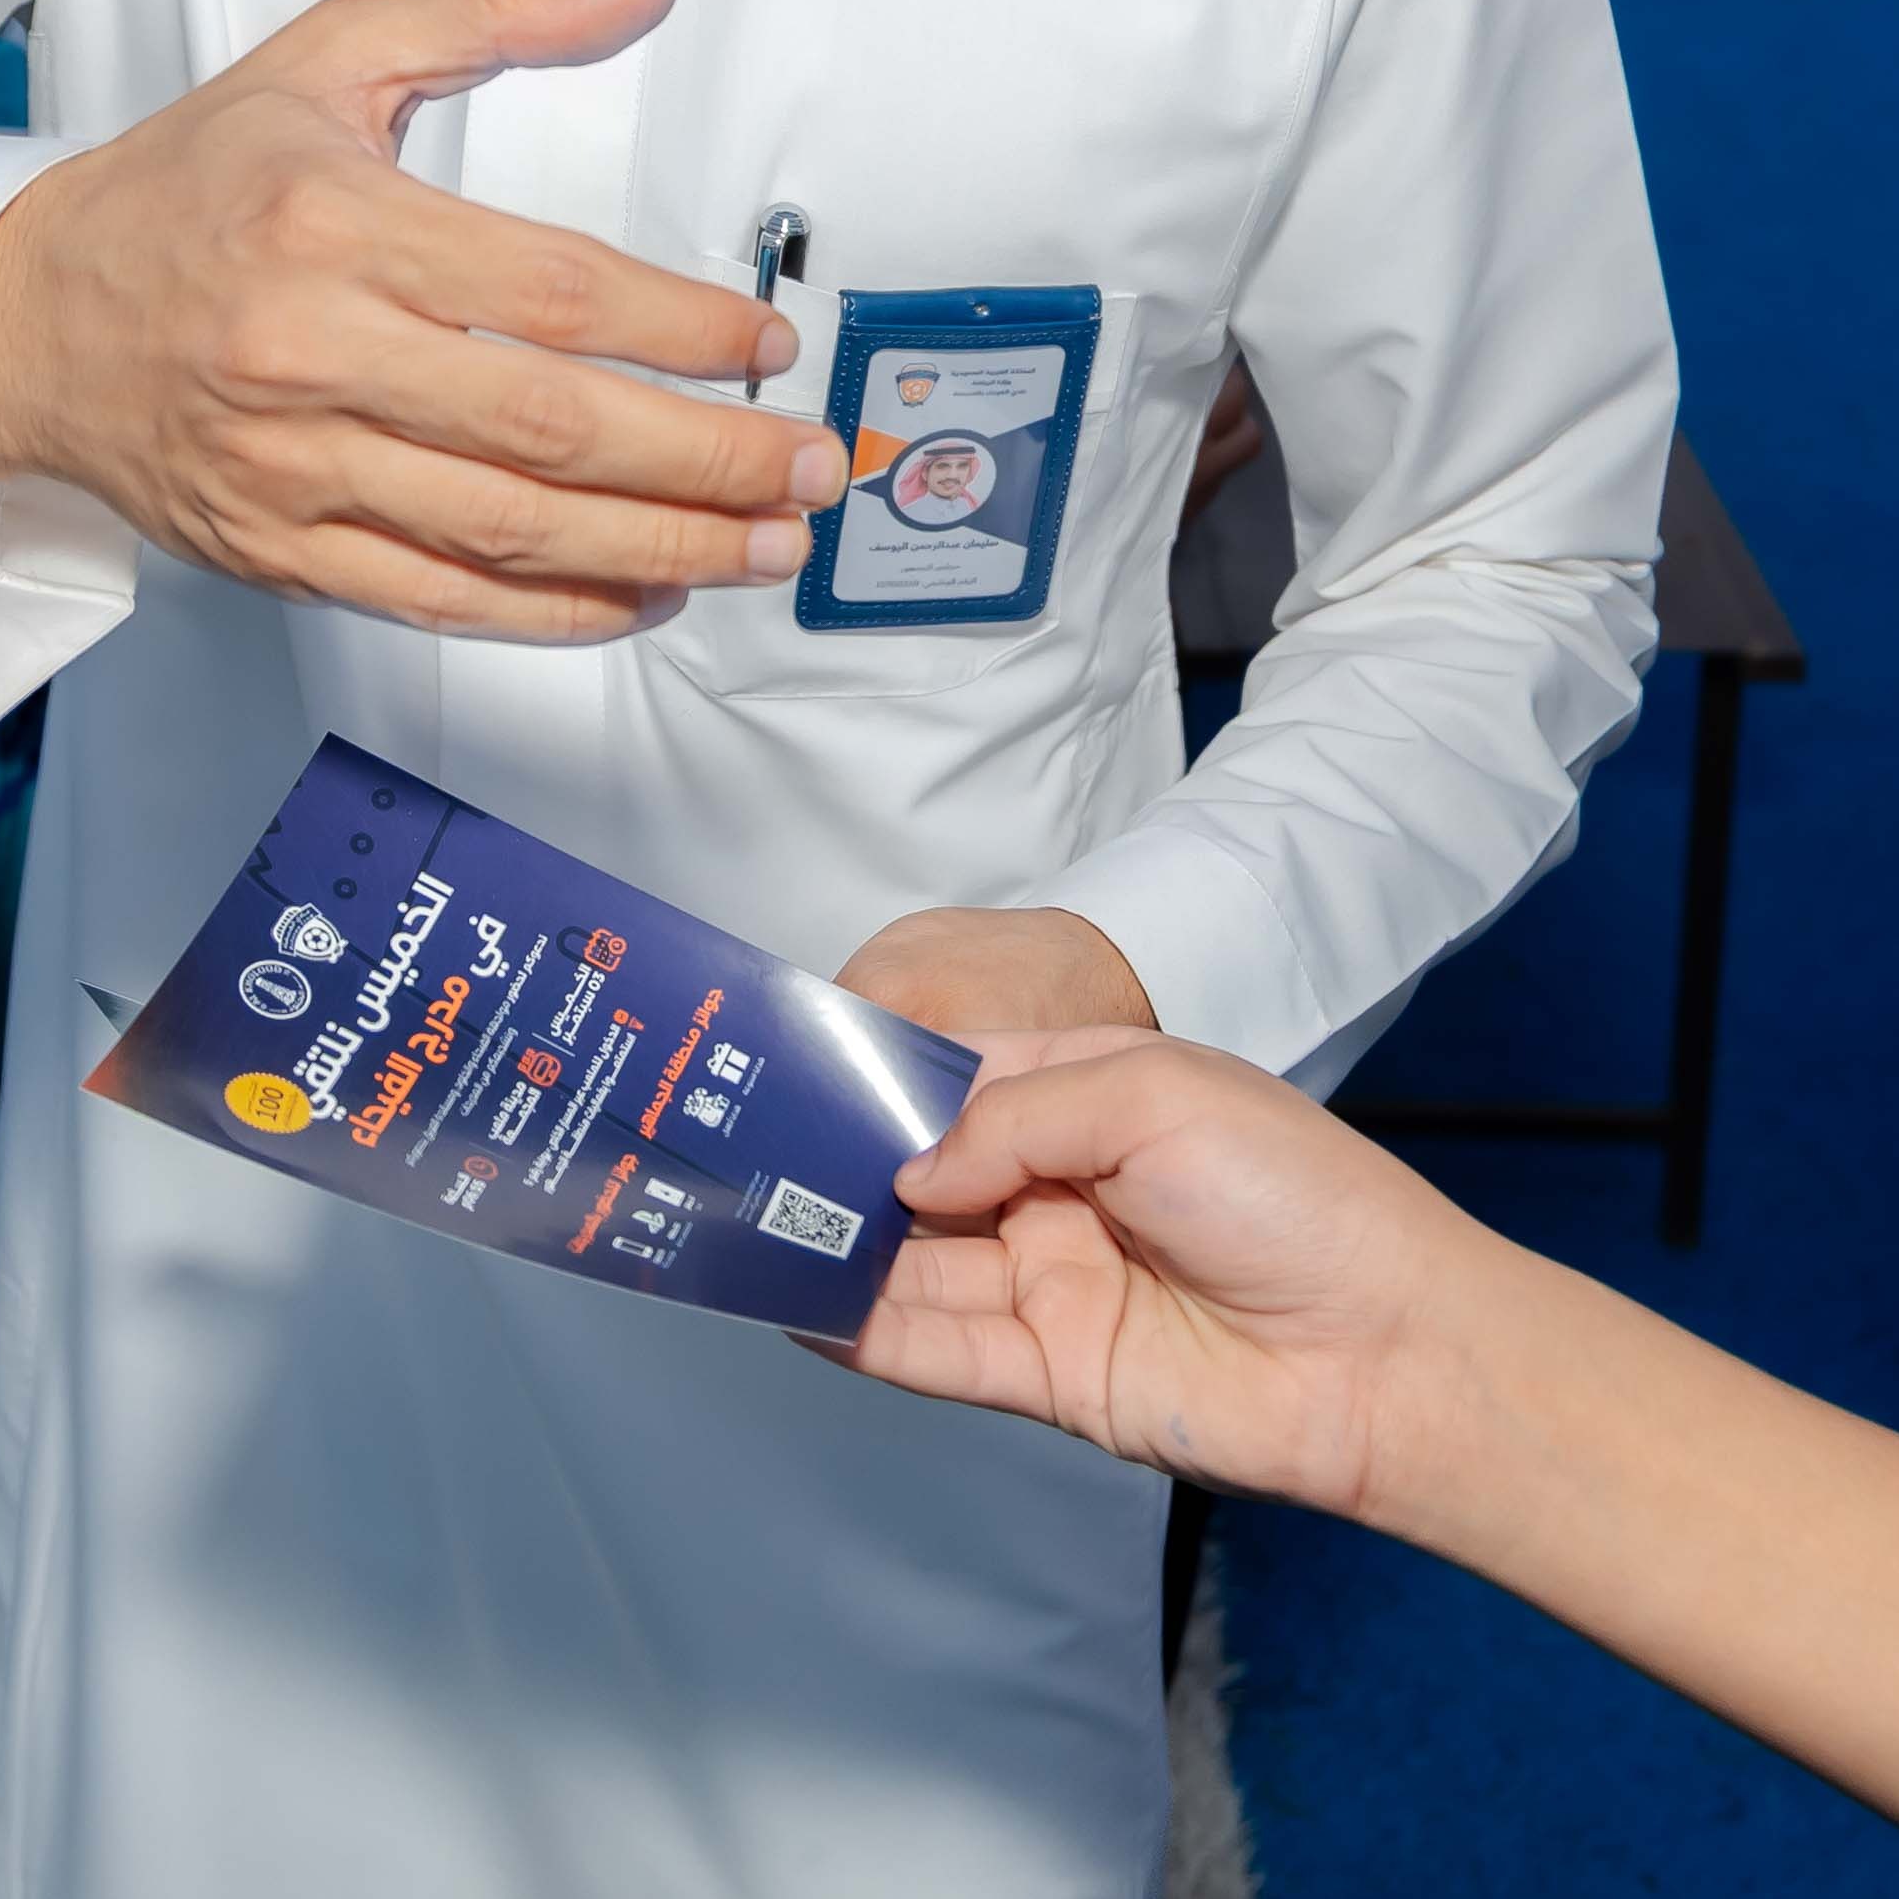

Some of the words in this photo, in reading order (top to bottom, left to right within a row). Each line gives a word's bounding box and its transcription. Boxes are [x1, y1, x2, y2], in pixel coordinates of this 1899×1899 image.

[356, 871, 454, 1032] الخميس
[468, 913, 509, 977] في
[523, 933, 547, 975] ندعوكم
[506, 969, 527, 1004] لحضور
[550, 962, 592, 1037] الخميس
[587, 970, 605, 991] 03
[407, 975, 470, 1064] مدرج
[561, 990, 595, 1046] سبتمبر
[692, 988, 723, 1029] جوائز
[598, 1023, 620, 1059] الدخول
[601, 1031, 636, 1086] استمتعوا
[662, 1027, 701, 1082] منطقة
[293, 1021, 363, 1121] نلتقي
[499, 1081, 533, 1112] مدينة
[580, 1055, 603, 1091] للملعب
[254, 1086, 284, 1121] 100
[348, 1051, 423, 1148] الفيحاء
[488, 1110, 509, 1140] ملعب
[639, 1078, 673, 1140] الجماهير
